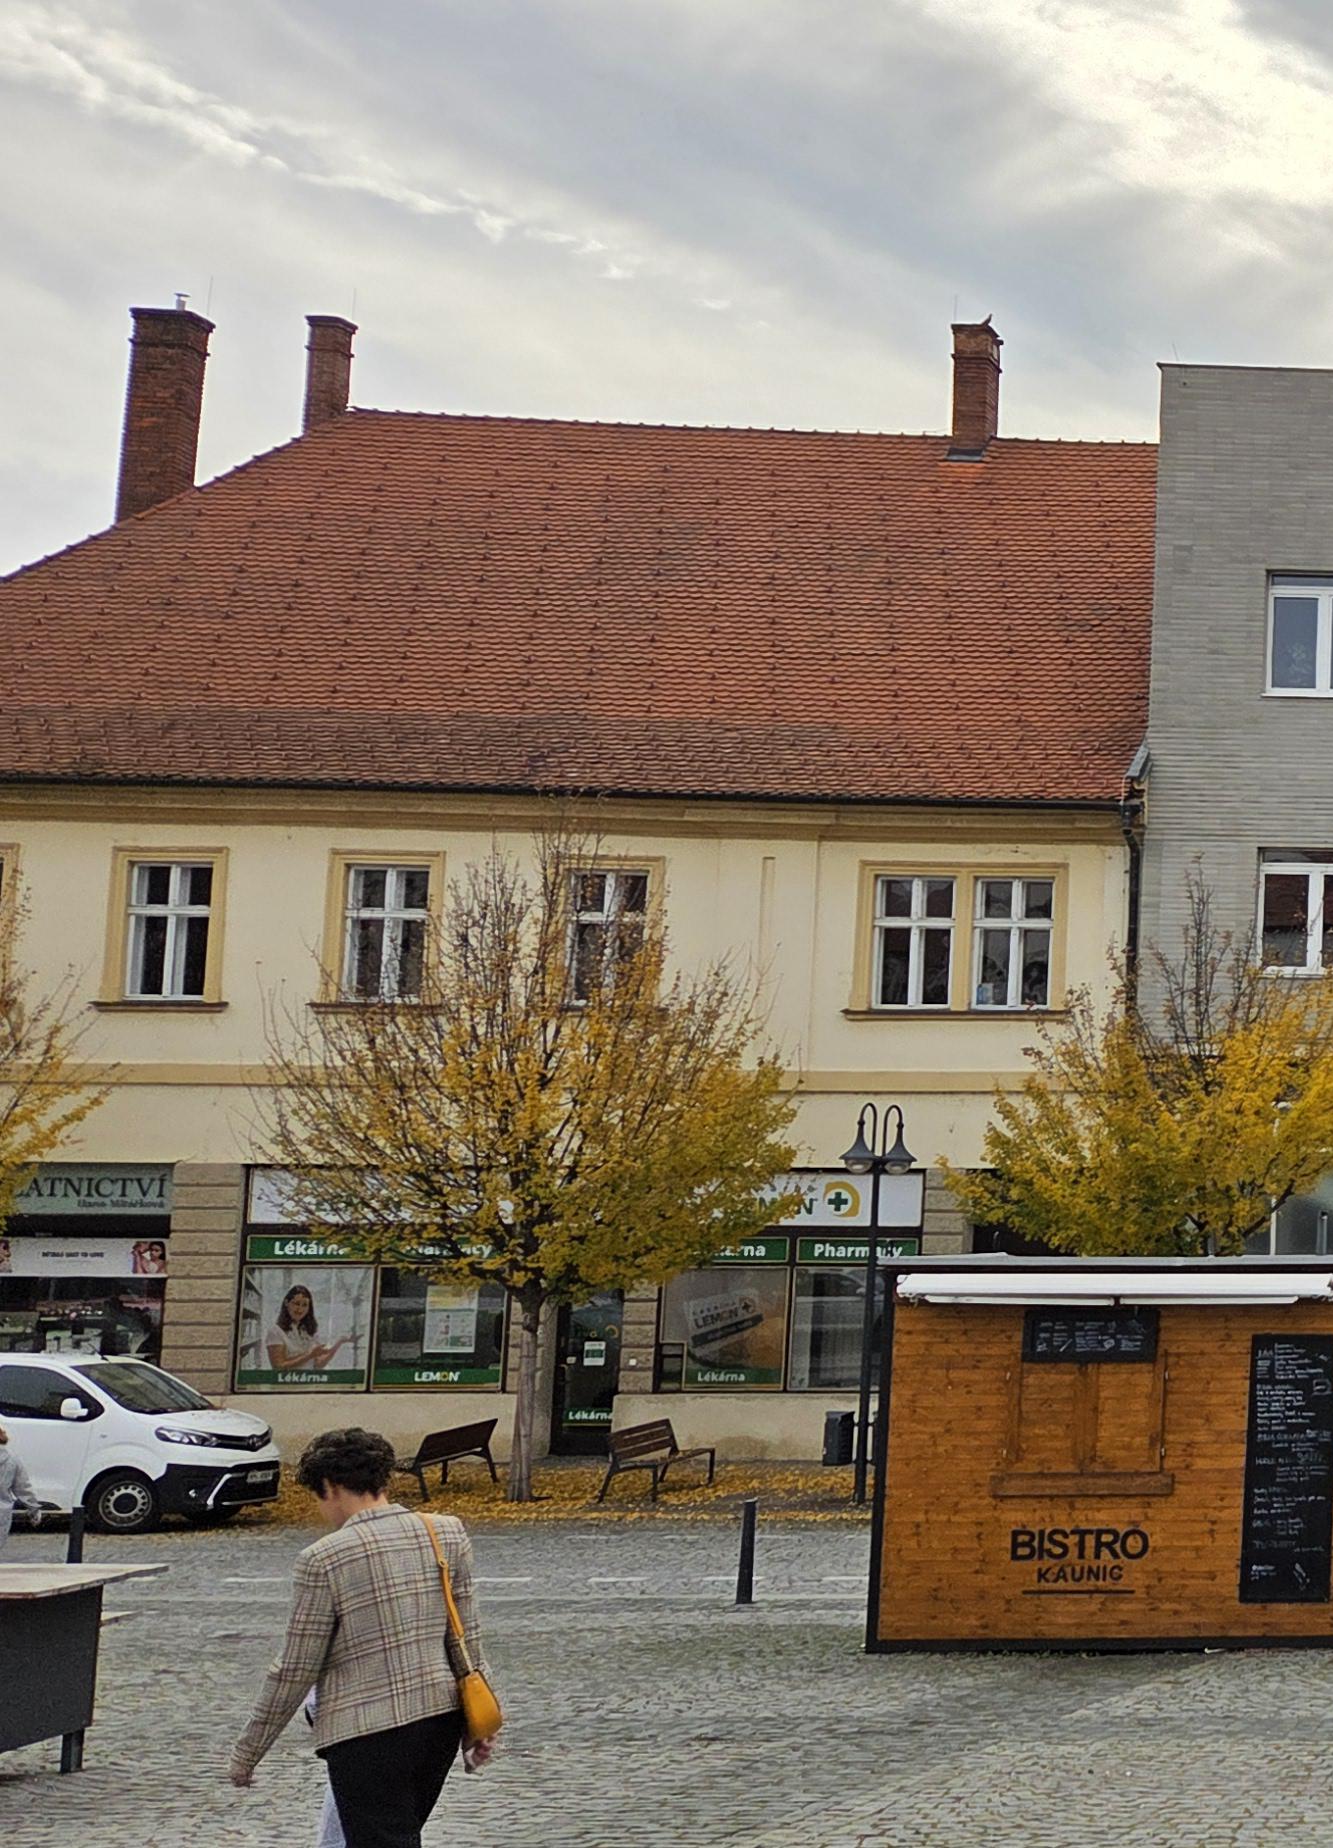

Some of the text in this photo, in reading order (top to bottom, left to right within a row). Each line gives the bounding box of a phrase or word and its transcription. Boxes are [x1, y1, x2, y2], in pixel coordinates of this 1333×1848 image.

[15, 1173, 168, 1198] ATNICTVÍ
[277, 1371, 328, 1383] Lékárna
[414, 1371, 460, 1382] LEMON
[697, 1371, 746, 1383] Lékárna
[1010, 1528, 1150, 1561] BISTRO
